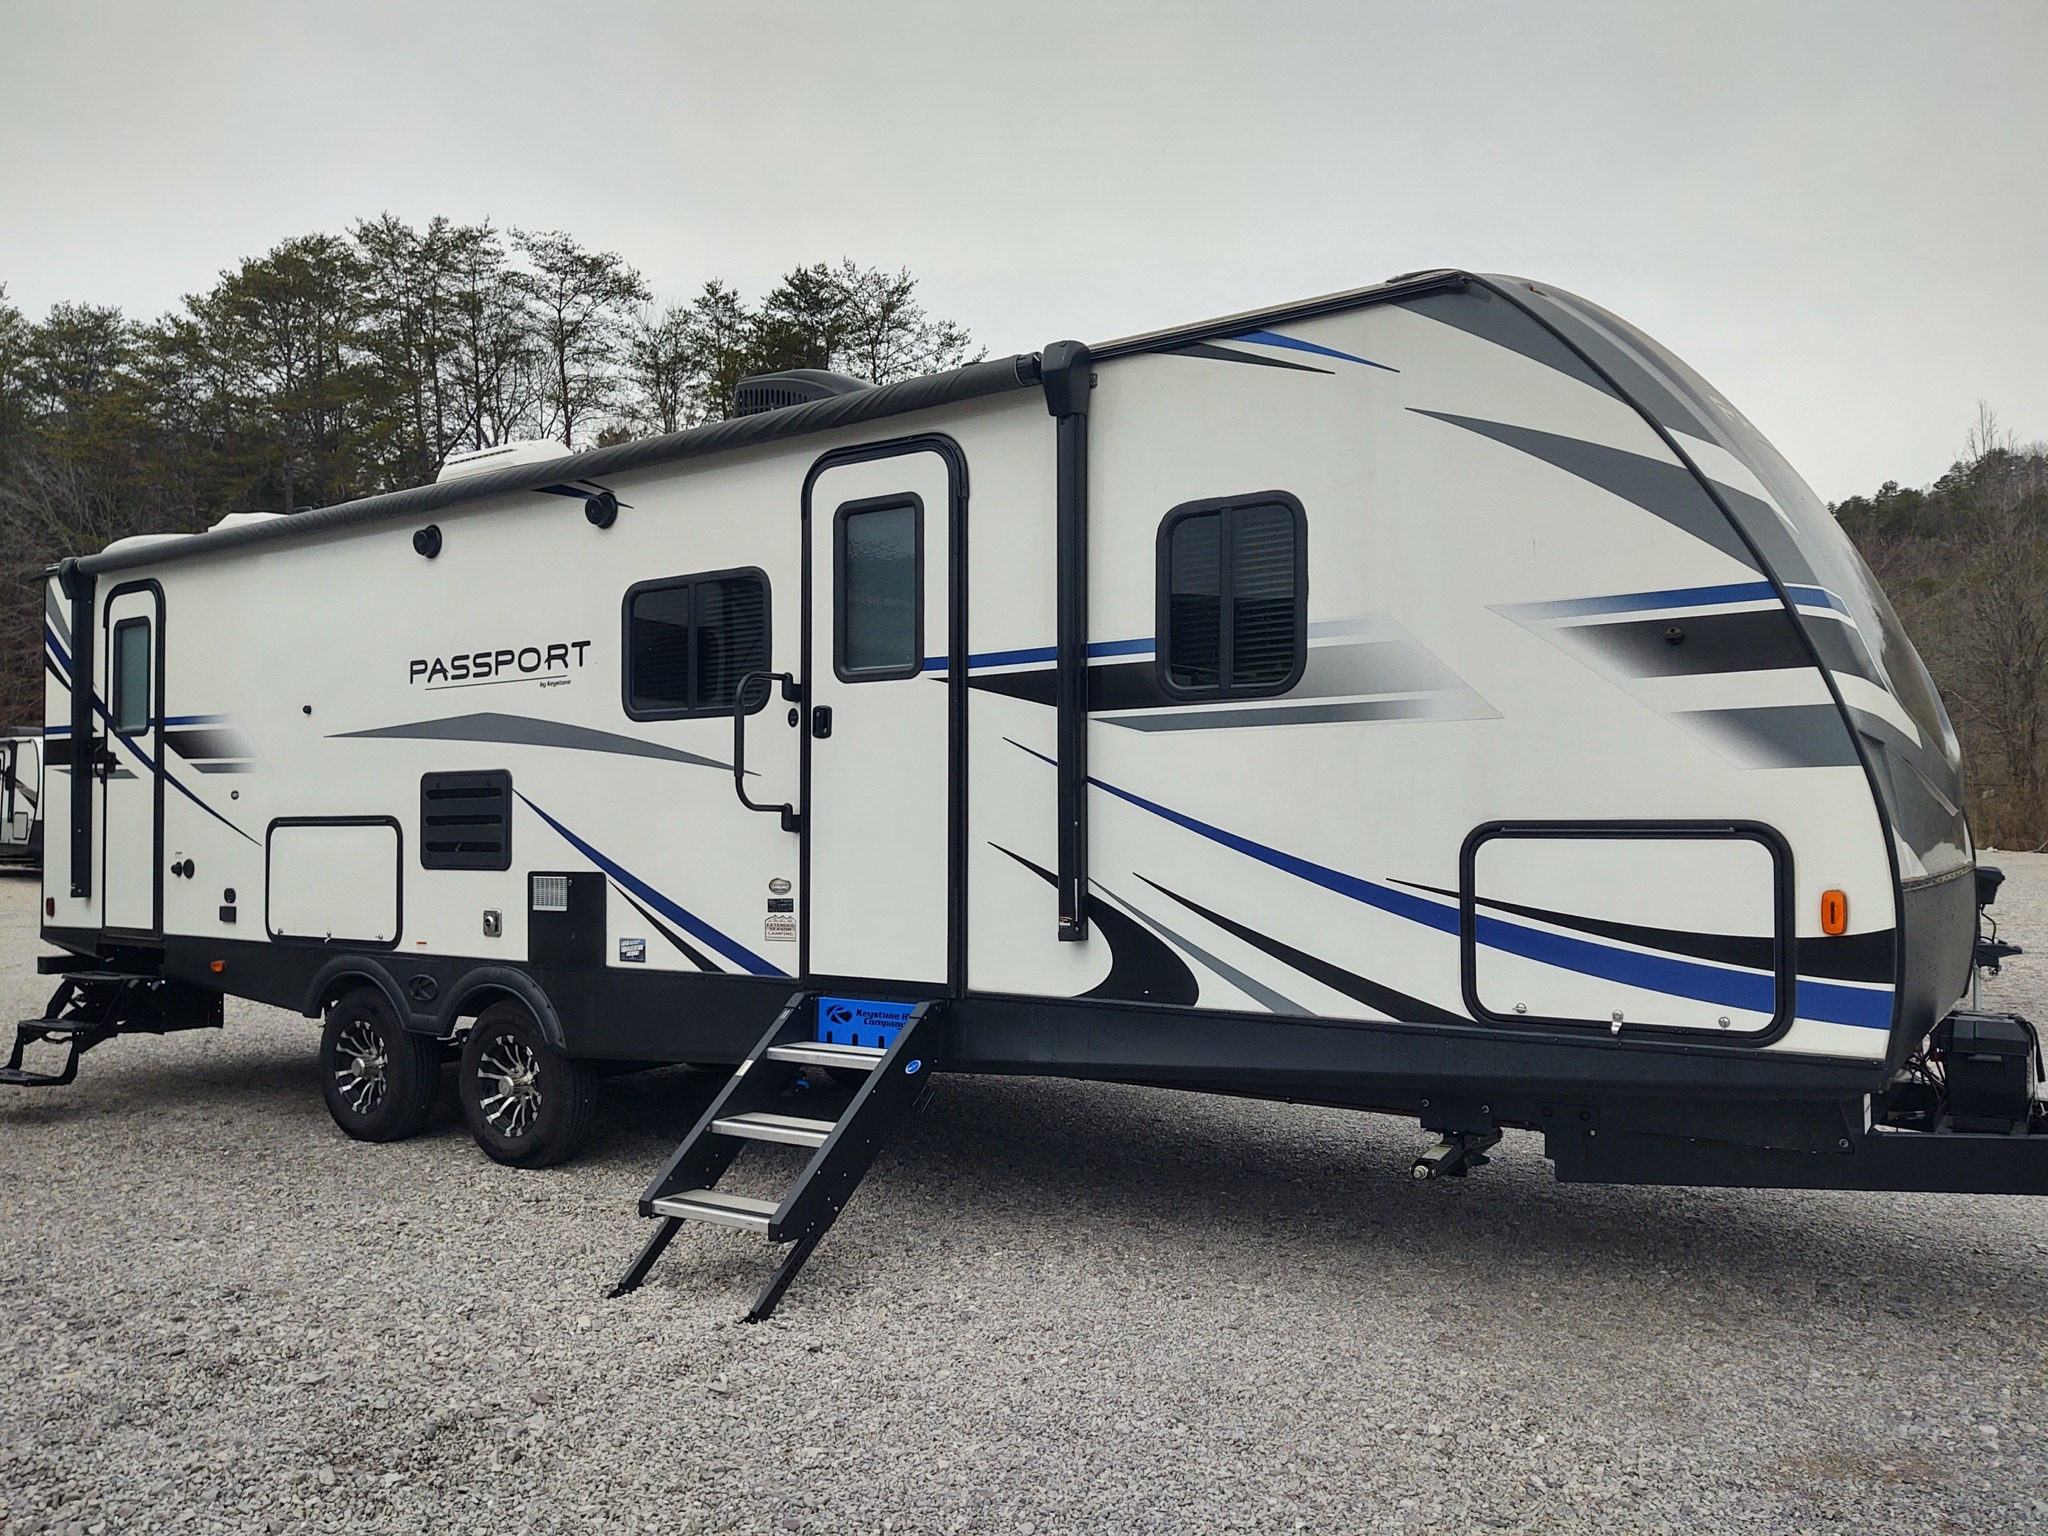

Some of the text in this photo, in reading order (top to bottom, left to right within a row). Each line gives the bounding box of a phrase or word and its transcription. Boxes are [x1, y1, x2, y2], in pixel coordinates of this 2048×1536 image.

[410, 640, 591, 685] PASSPORT
[856, 1008, 911, 1020] Keystone R
[864, 1018, 907, 1030] Company
